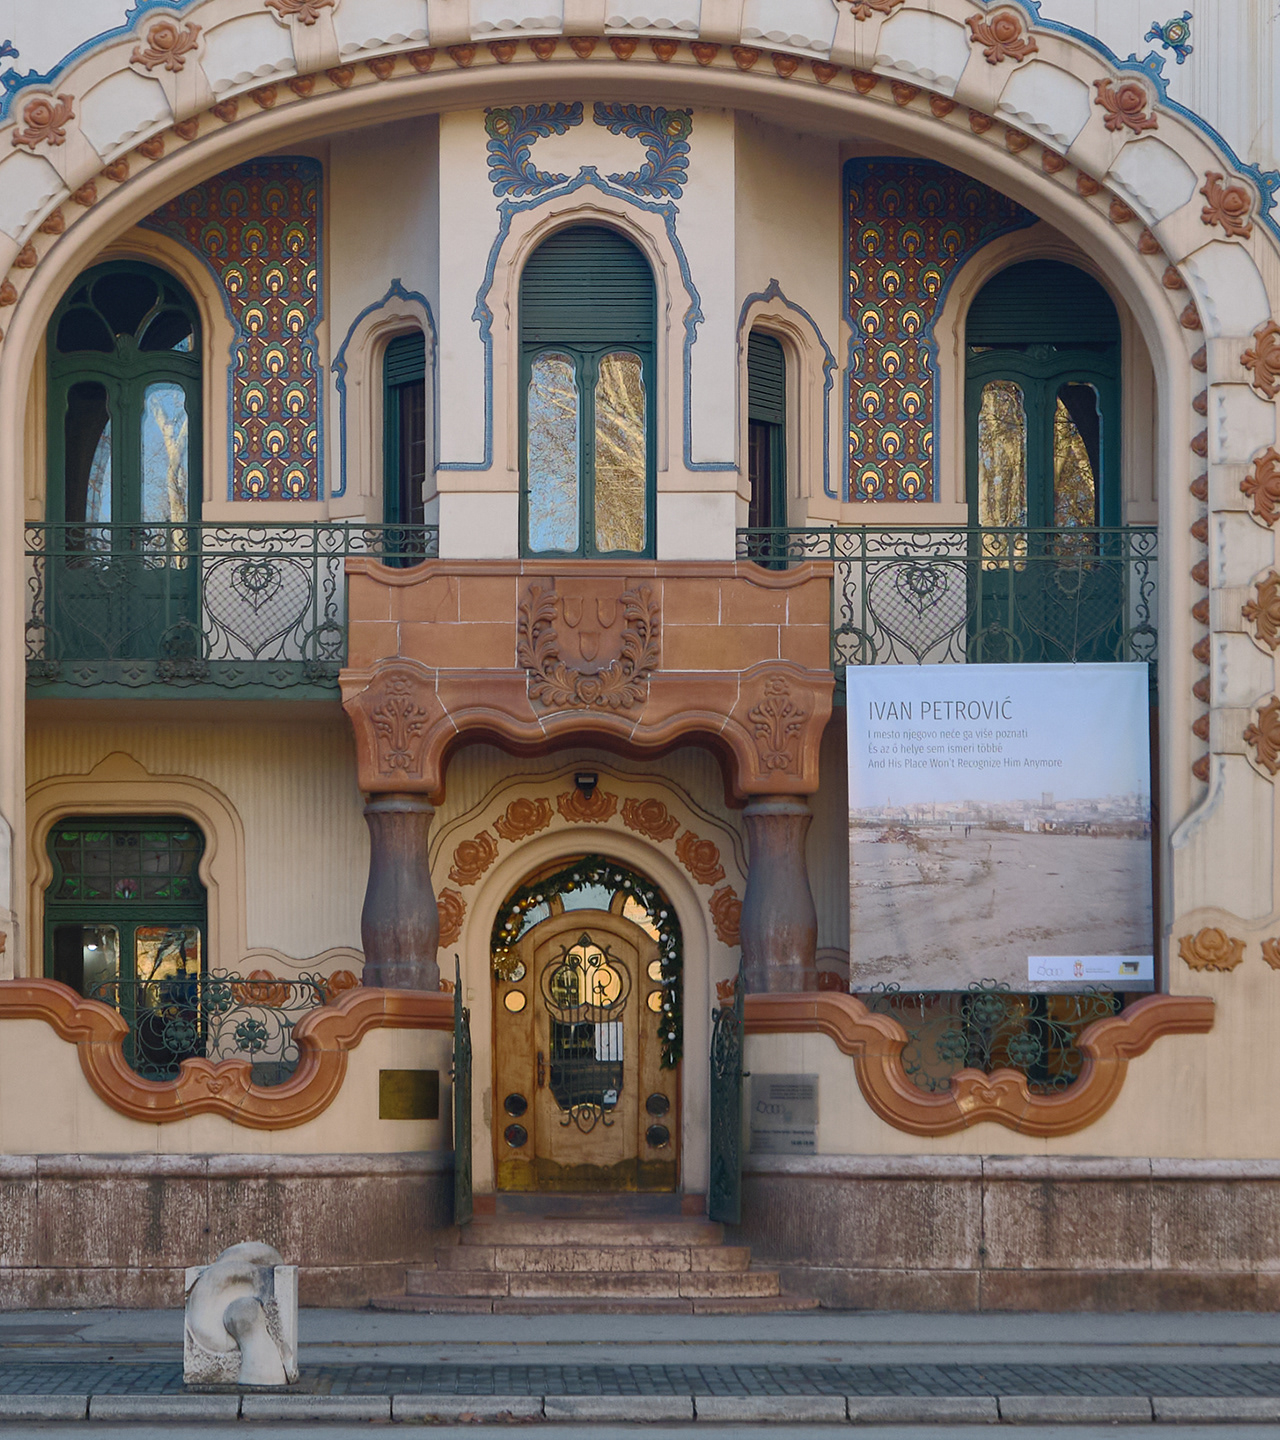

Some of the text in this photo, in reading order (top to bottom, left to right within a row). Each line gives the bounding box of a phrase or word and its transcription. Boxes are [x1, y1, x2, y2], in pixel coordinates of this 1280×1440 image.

[869, 696, 1013, 721] IVAN PETROVIĆ
[873, 729, 900, 739] mesto
[903, 728, 937, 741] njegovo
[940, 728, 961, 739] neće
[963, 730, 973, 741] ga
[975, 728, 993, 739] više
[995, 728, 1028, 740] poznati
[868, 742, 878, 754] És
[880, 745, 890, 754] az
[900, 743, 924, 756] helye
[926, 745, 945, 754] sem
[947, 742, 975, 754] ismeri
[977, 742, 1003, 753] többé
[868, 757, 1063, 771] And His Place Won't Recognize Him Anymore
